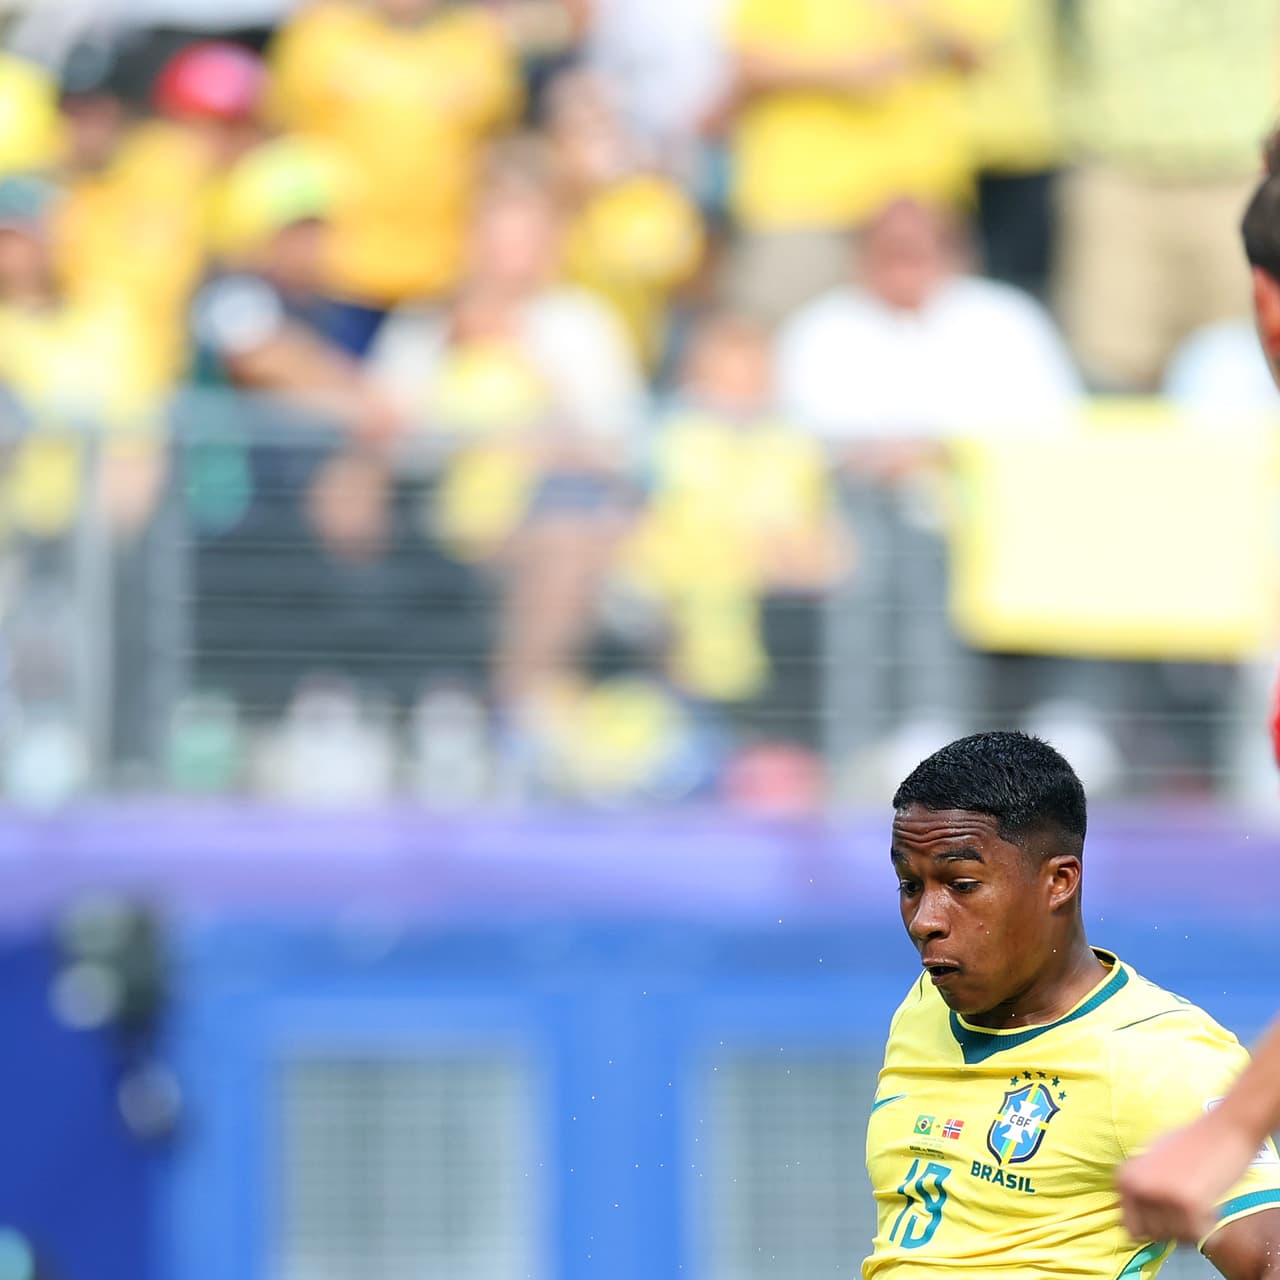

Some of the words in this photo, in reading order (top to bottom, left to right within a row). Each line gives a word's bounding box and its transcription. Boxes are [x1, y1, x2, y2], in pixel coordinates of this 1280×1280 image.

[1009, 1114, 1033, 1128] CBF
[970, 1160, 1036, 1194] BRASIL
[888, 1158, 953, 1250] 19
